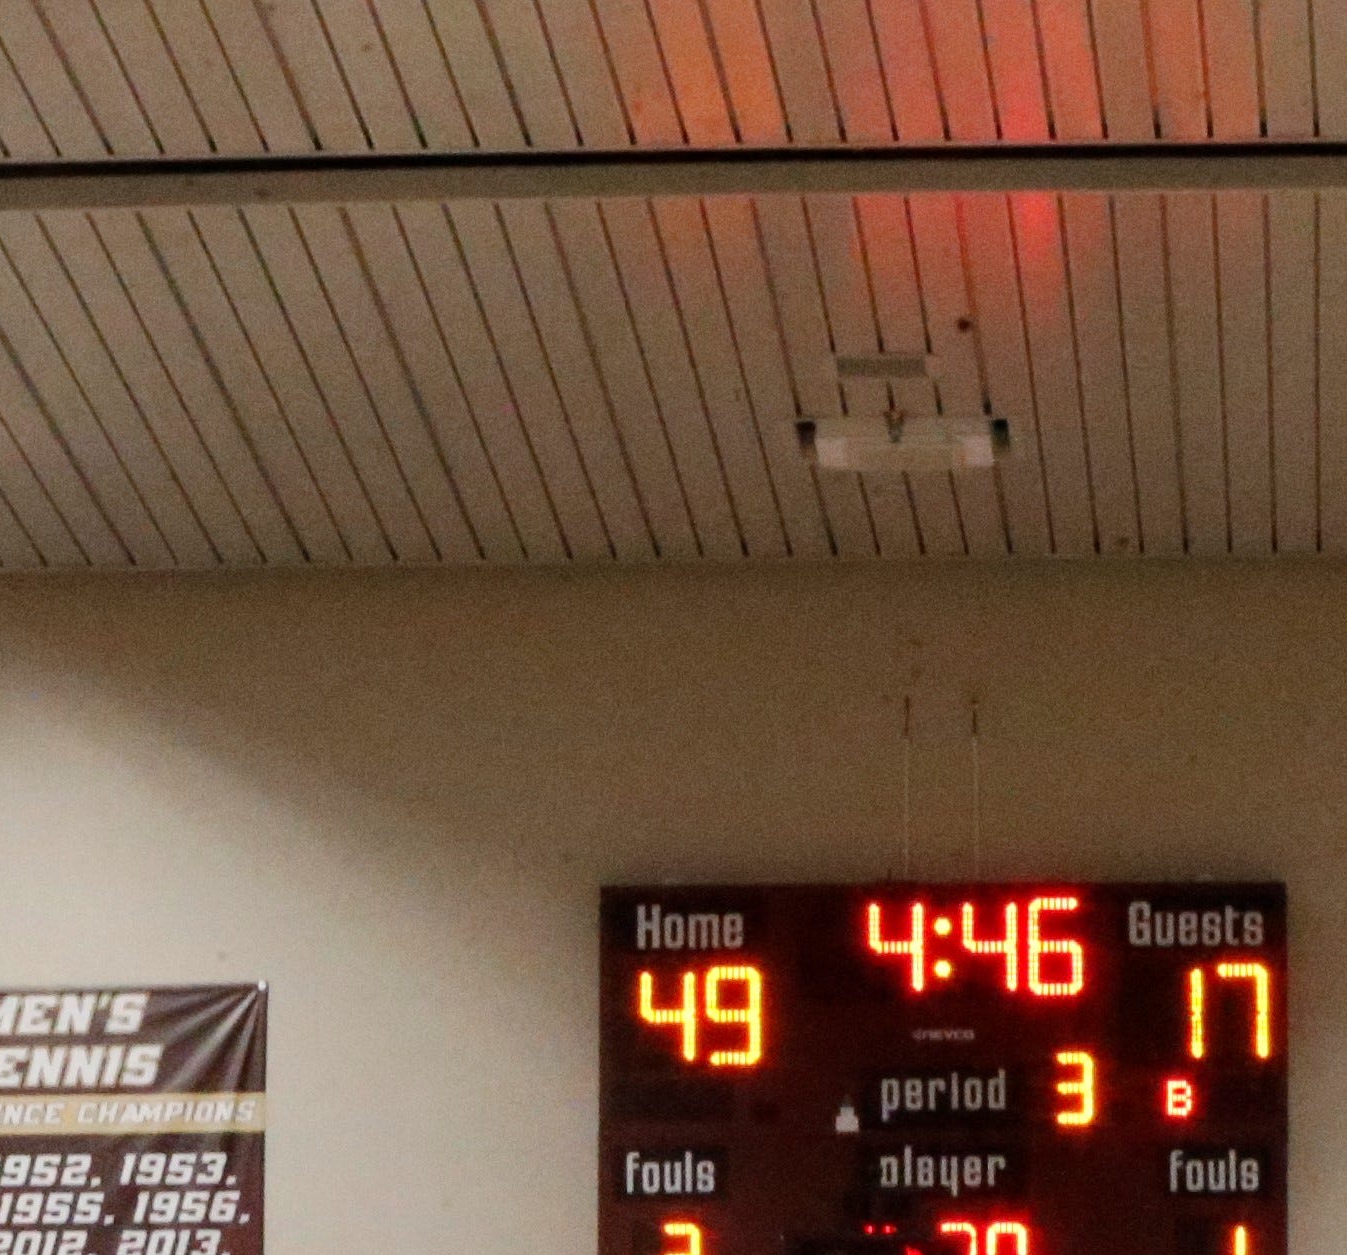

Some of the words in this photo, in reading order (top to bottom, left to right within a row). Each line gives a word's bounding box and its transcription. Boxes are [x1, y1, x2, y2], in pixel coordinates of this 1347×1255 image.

[637, 903, 744, 950] Home
[869, 897, 1084, 996] 4:46
[1128, 900, 1264, 947] Guests
[639, 965, 762, 1067] 49
[1189, 962, 1270, 1060] 17
[77, 1098, 256, 1126] CHAMPIONS
[881, 1068, 1006, 1123] period
[1056, 1051, 1095, 1126] 3
[626, 1150, 715, 1195] fouls
[1169, 1149, 1260, 1193] fouls
